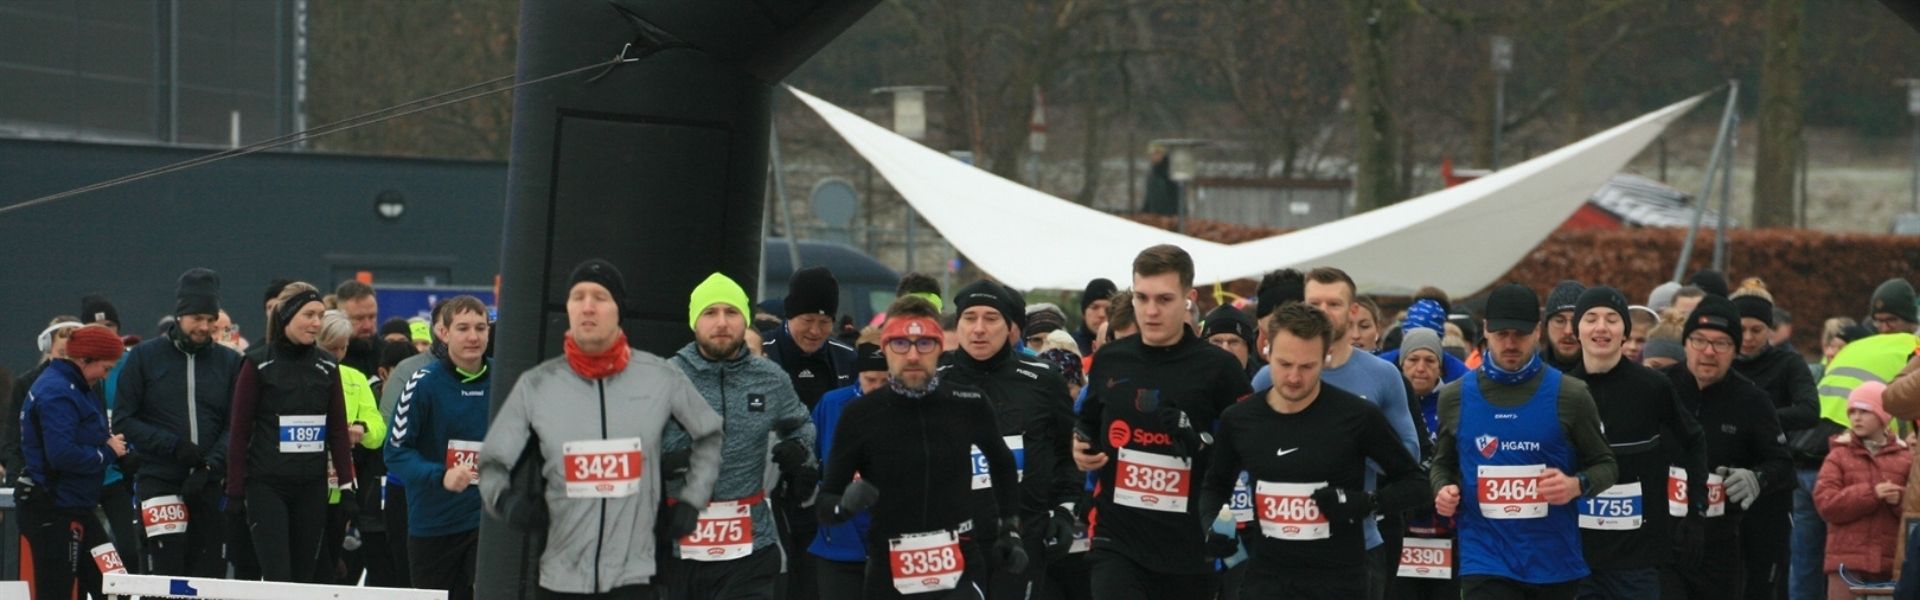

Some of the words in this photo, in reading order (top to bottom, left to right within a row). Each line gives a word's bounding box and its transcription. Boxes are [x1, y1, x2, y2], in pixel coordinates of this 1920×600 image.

[287, 427, 321, 441] 1897
[1501, 440, 1540, 452] HGATM
[574, 453, 630, 480] 3421
[1123, 464, 1181, 494] 3382
[1485, 478, 1538, 501] 3464
[148, 504, 185, 523] 3496
[1264, 496, 1320, 521] 3466
[1586, 498, 1633, 516] 1755
[688, 520, 742, 543] 3475
[899, 546, 957, 576] 3358
[1401, 548, 1444, 566] 3390
